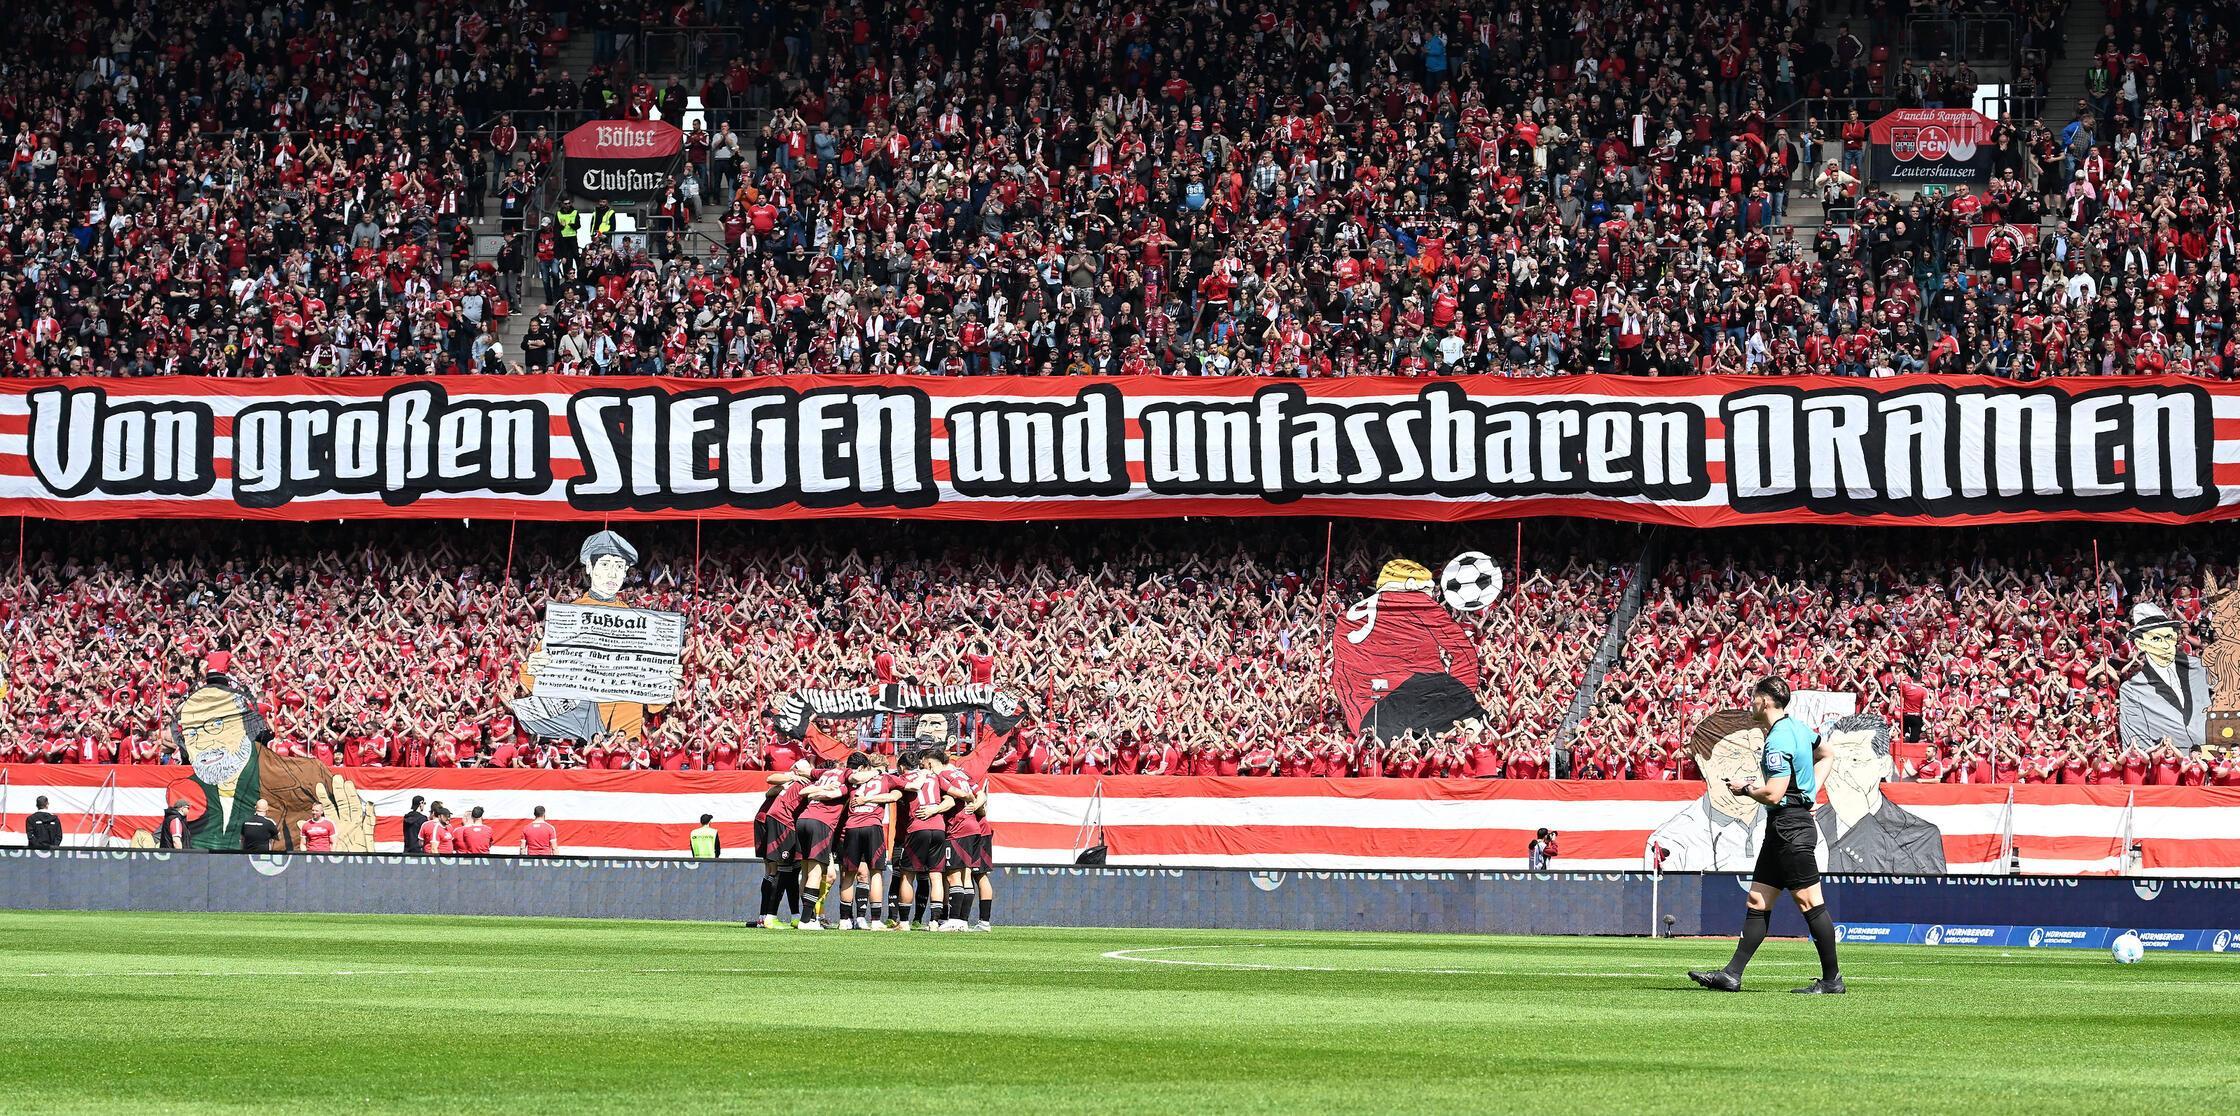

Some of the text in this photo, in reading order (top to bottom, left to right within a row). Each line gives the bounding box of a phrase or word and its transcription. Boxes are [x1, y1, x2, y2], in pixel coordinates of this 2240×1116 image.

[1897, 110, 1935, 122] Fanclub
[596, 126, 656, 150] Böhse
[1919, 141, 1947, 151] FCN
[582, 168, 665, 192] Clubfanz
[1891, 164, 1976, 177] Leutershausen
[29, 390, 2204, 500] Von großen SIEGEN und unfassbaren DRAMEN
[581, 611, 648, 630] Fußball
[635, 655, 676, 665] Kontinent
[797, 685, 874, 713] NUMMER
